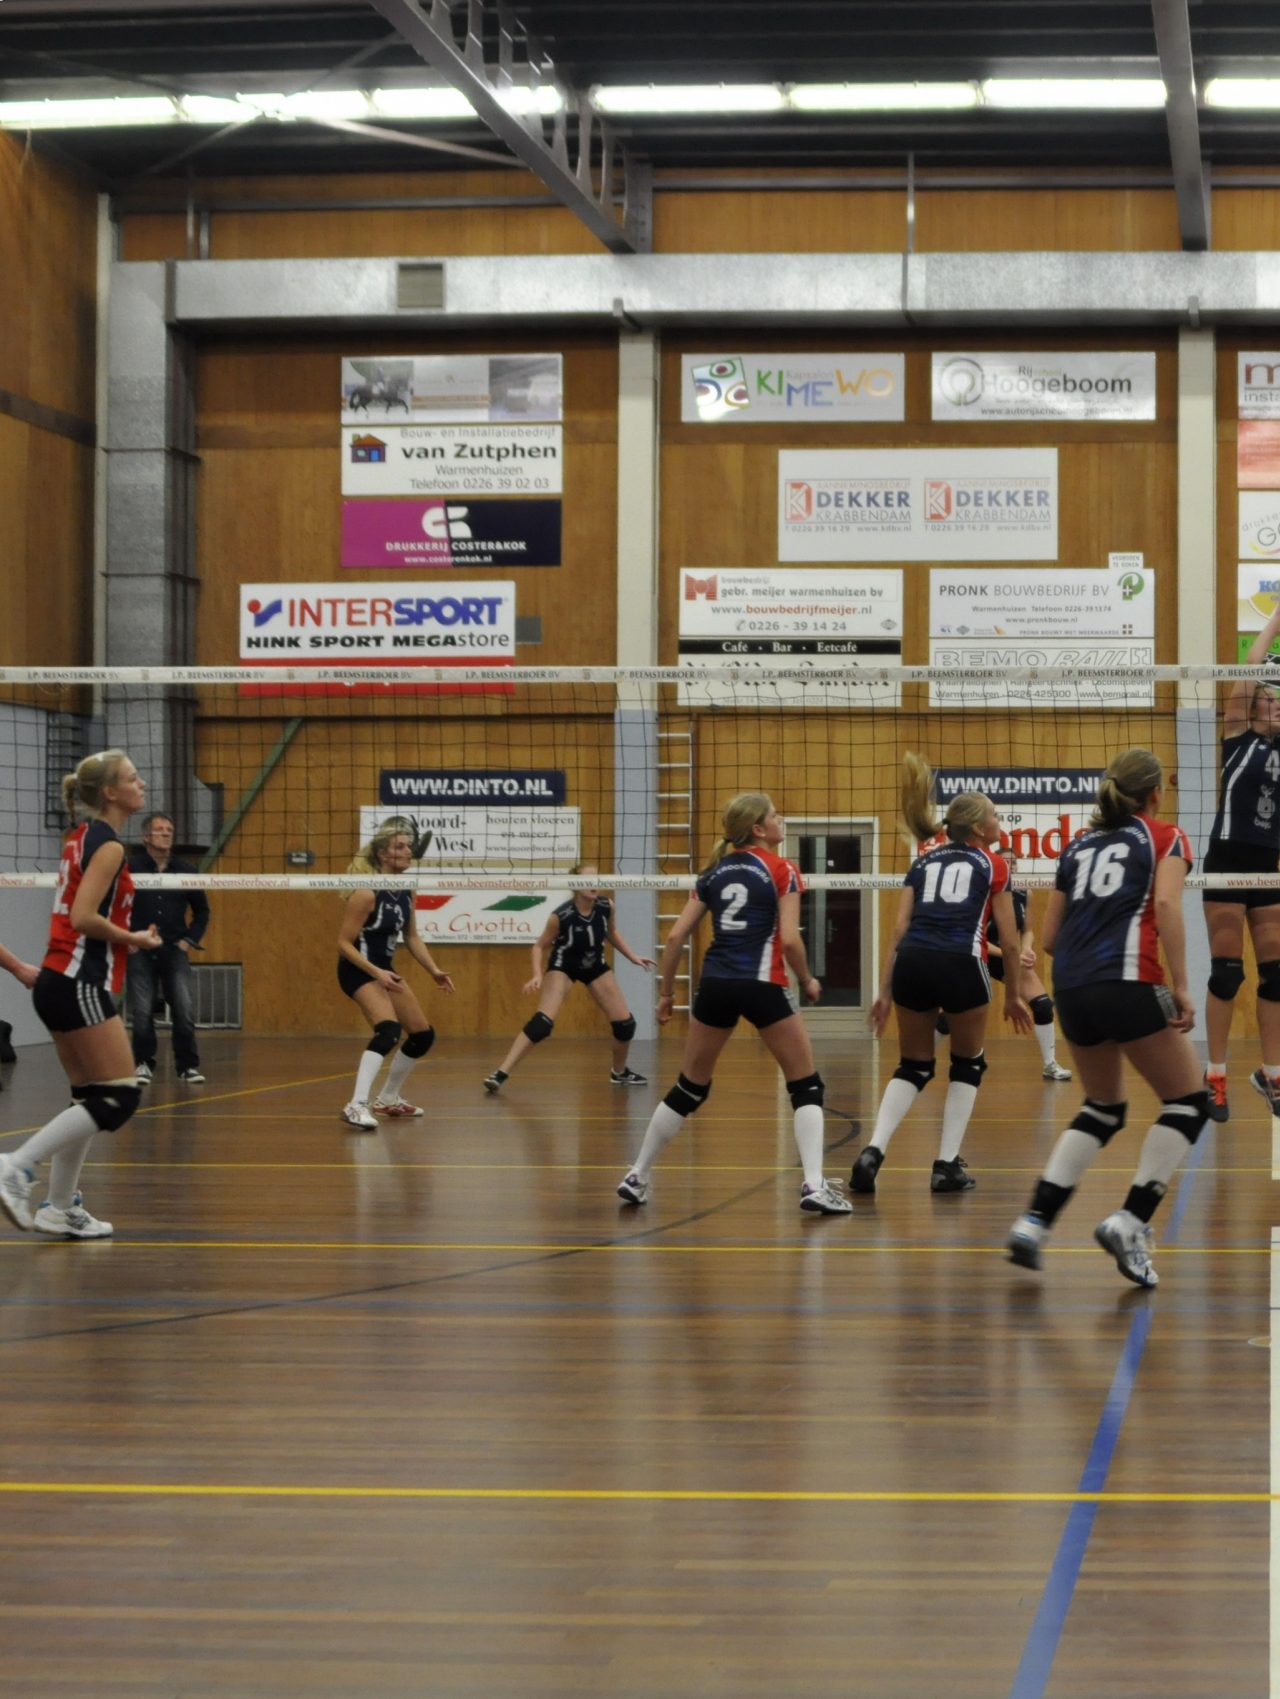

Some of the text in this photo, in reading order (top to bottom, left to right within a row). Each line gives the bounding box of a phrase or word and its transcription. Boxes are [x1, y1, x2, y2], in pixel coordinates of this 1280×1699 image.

[983, 373, 1132, 398] Hoogeboom
[402, 443, 557, 462] van Zutphen
[435, 465, 524, 476] Warmenhuizen
[410, 478, 550, 489] Telefoon 0226 39 02 03
[816, 491, 911, 508] DEKKER
[956, 490, 1050, 507] DEKKER
[816, 510, 911, 521] KRABBENDAM
[955, 509, 1050, 521] KRABBENDAM
[386, 542, 449, 552] DRUKKERIJ
[721, 586, 883, 598] gebr. meijer warmenhuizen bv
[939, 585, 1110, 597] PRONK BOUWBEDRIJF BV
[290, 597, 502, 627] INTERSPORT
[711, 605, 872, 617] www.bouwbedrijfmeijer.nl
[749, 621, 847, 631] 0226 39 14 24
[309, 636, 384, 648] SPORT
[392, 632, 510, 647] MEGAstore
[722, 642, 749, 653] Café
[773, 643, 792, 653] Bar
[334, 671, 398, 679] BEEMSTERBOER
[482, 671, 546, 679] BEEMSTERBOER
[630, 671, 694, 679] BEEMSTERBOER
[779, 670, 843, 679] BEEMSTERBOER
[927, 670, 992, 678] BEEMSTERBOER
[1078, 669, 1143, 678] BEEMSTERBOER
[1265, 750, 1280, 782] 4
[389, 778, 553, 795] WWW.DINTO.NL
[486, 813, 575, 824] houten vloeren
[435, 837, 474, 852] West
[1072, 842, 1130, 901] 16
[181, 877, 290, 889] www.beemsterboer.nl
[308, 877, 418, 889] www.beemsterboer.nl
[437, 877, 549, 889] www.beemsterboer.nl
[567, 877, 679, 888] www.beemsterboer.nl
[922, 861, 973, 903] 10
[720, 883, 748, 931] 2
[449, 913, 532, 933] Grotta
